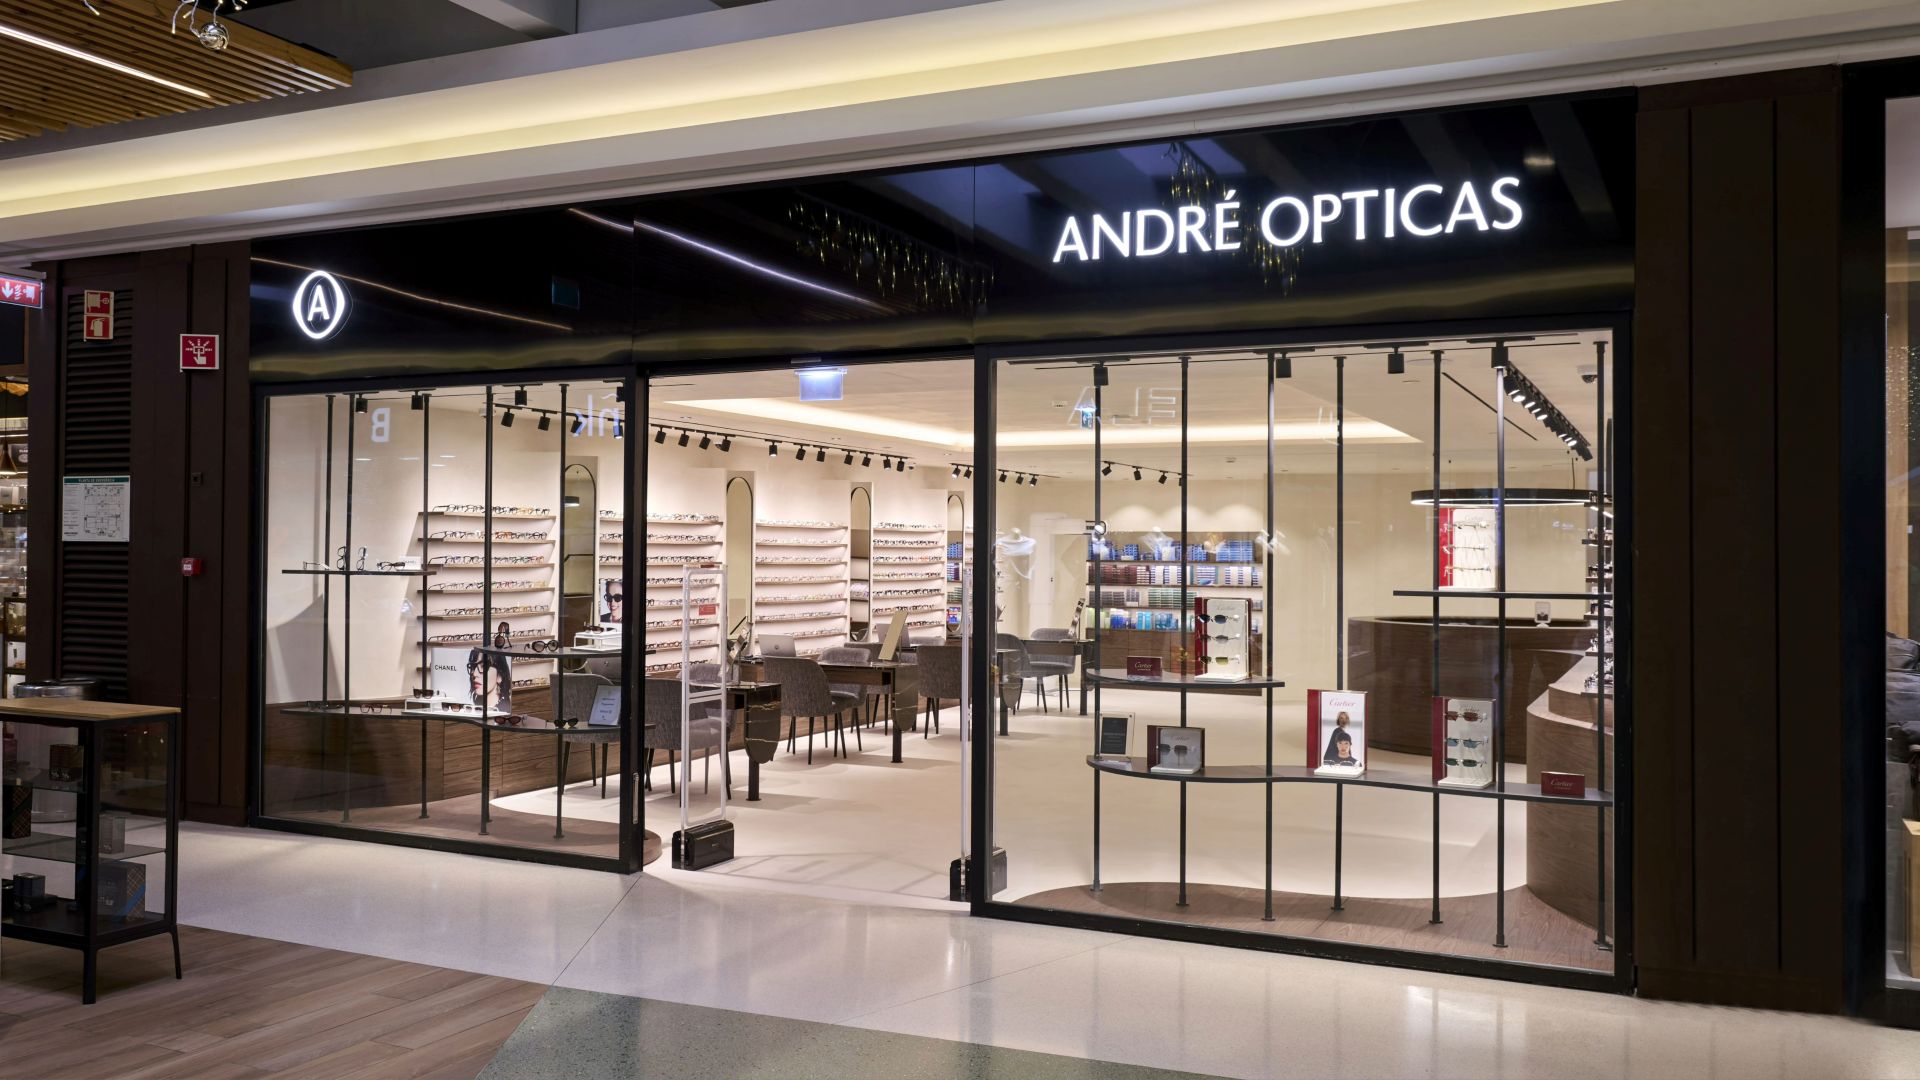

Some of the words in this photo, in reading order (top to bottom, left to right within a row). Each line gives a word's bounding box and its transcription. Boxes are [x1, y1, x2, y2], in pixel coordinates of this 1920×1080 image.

[1052, 190, 1241, 263] ANDRÉ
[1261, 176, 1523, 247] OPTICAS
[1329, 697, 1356, 707] Cartier
